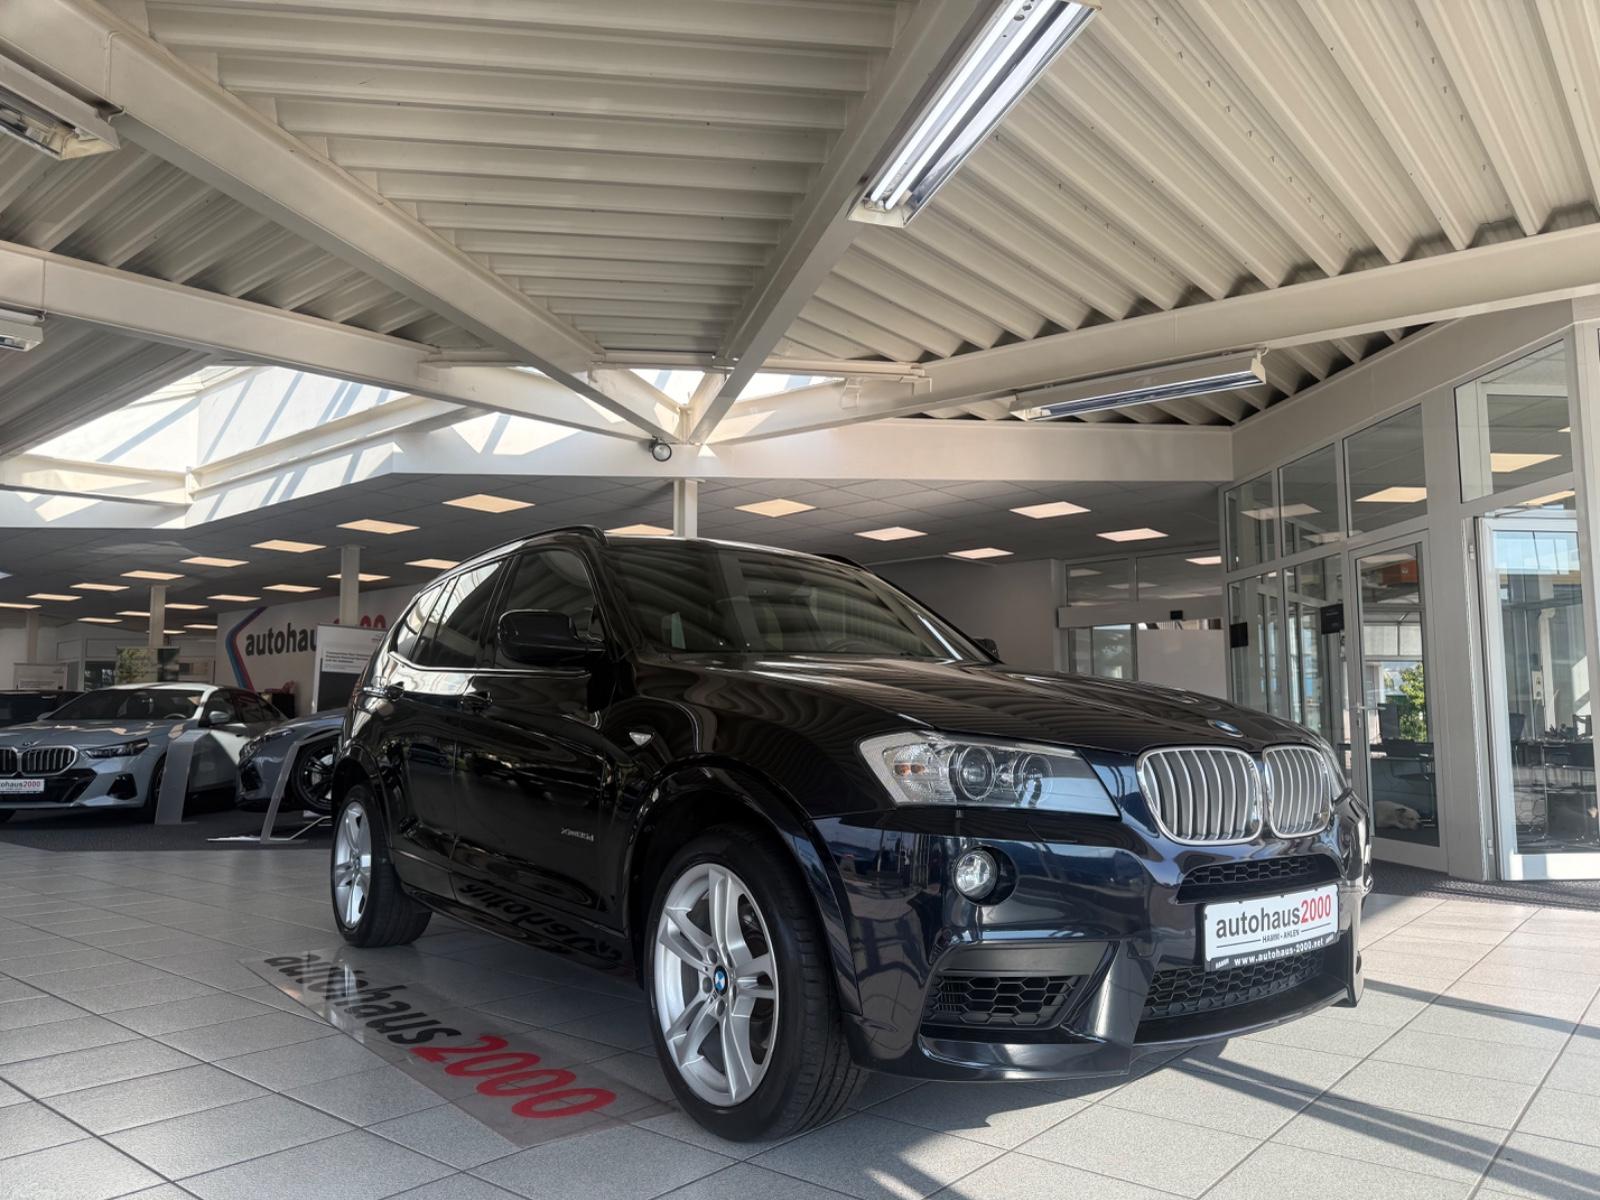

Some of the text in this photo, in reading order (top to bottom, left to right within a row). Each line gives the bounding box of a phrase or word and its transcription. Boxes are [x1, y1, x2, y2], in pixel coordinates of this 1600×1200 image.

[0, 780, 40, 788] ohaus2000
[1216, 894, 1331, 938] autohaus2000
[1234, 938, 1324, 967] www.autohaus-2000.net
[264, 954, 617, 1119] autohaus2000
